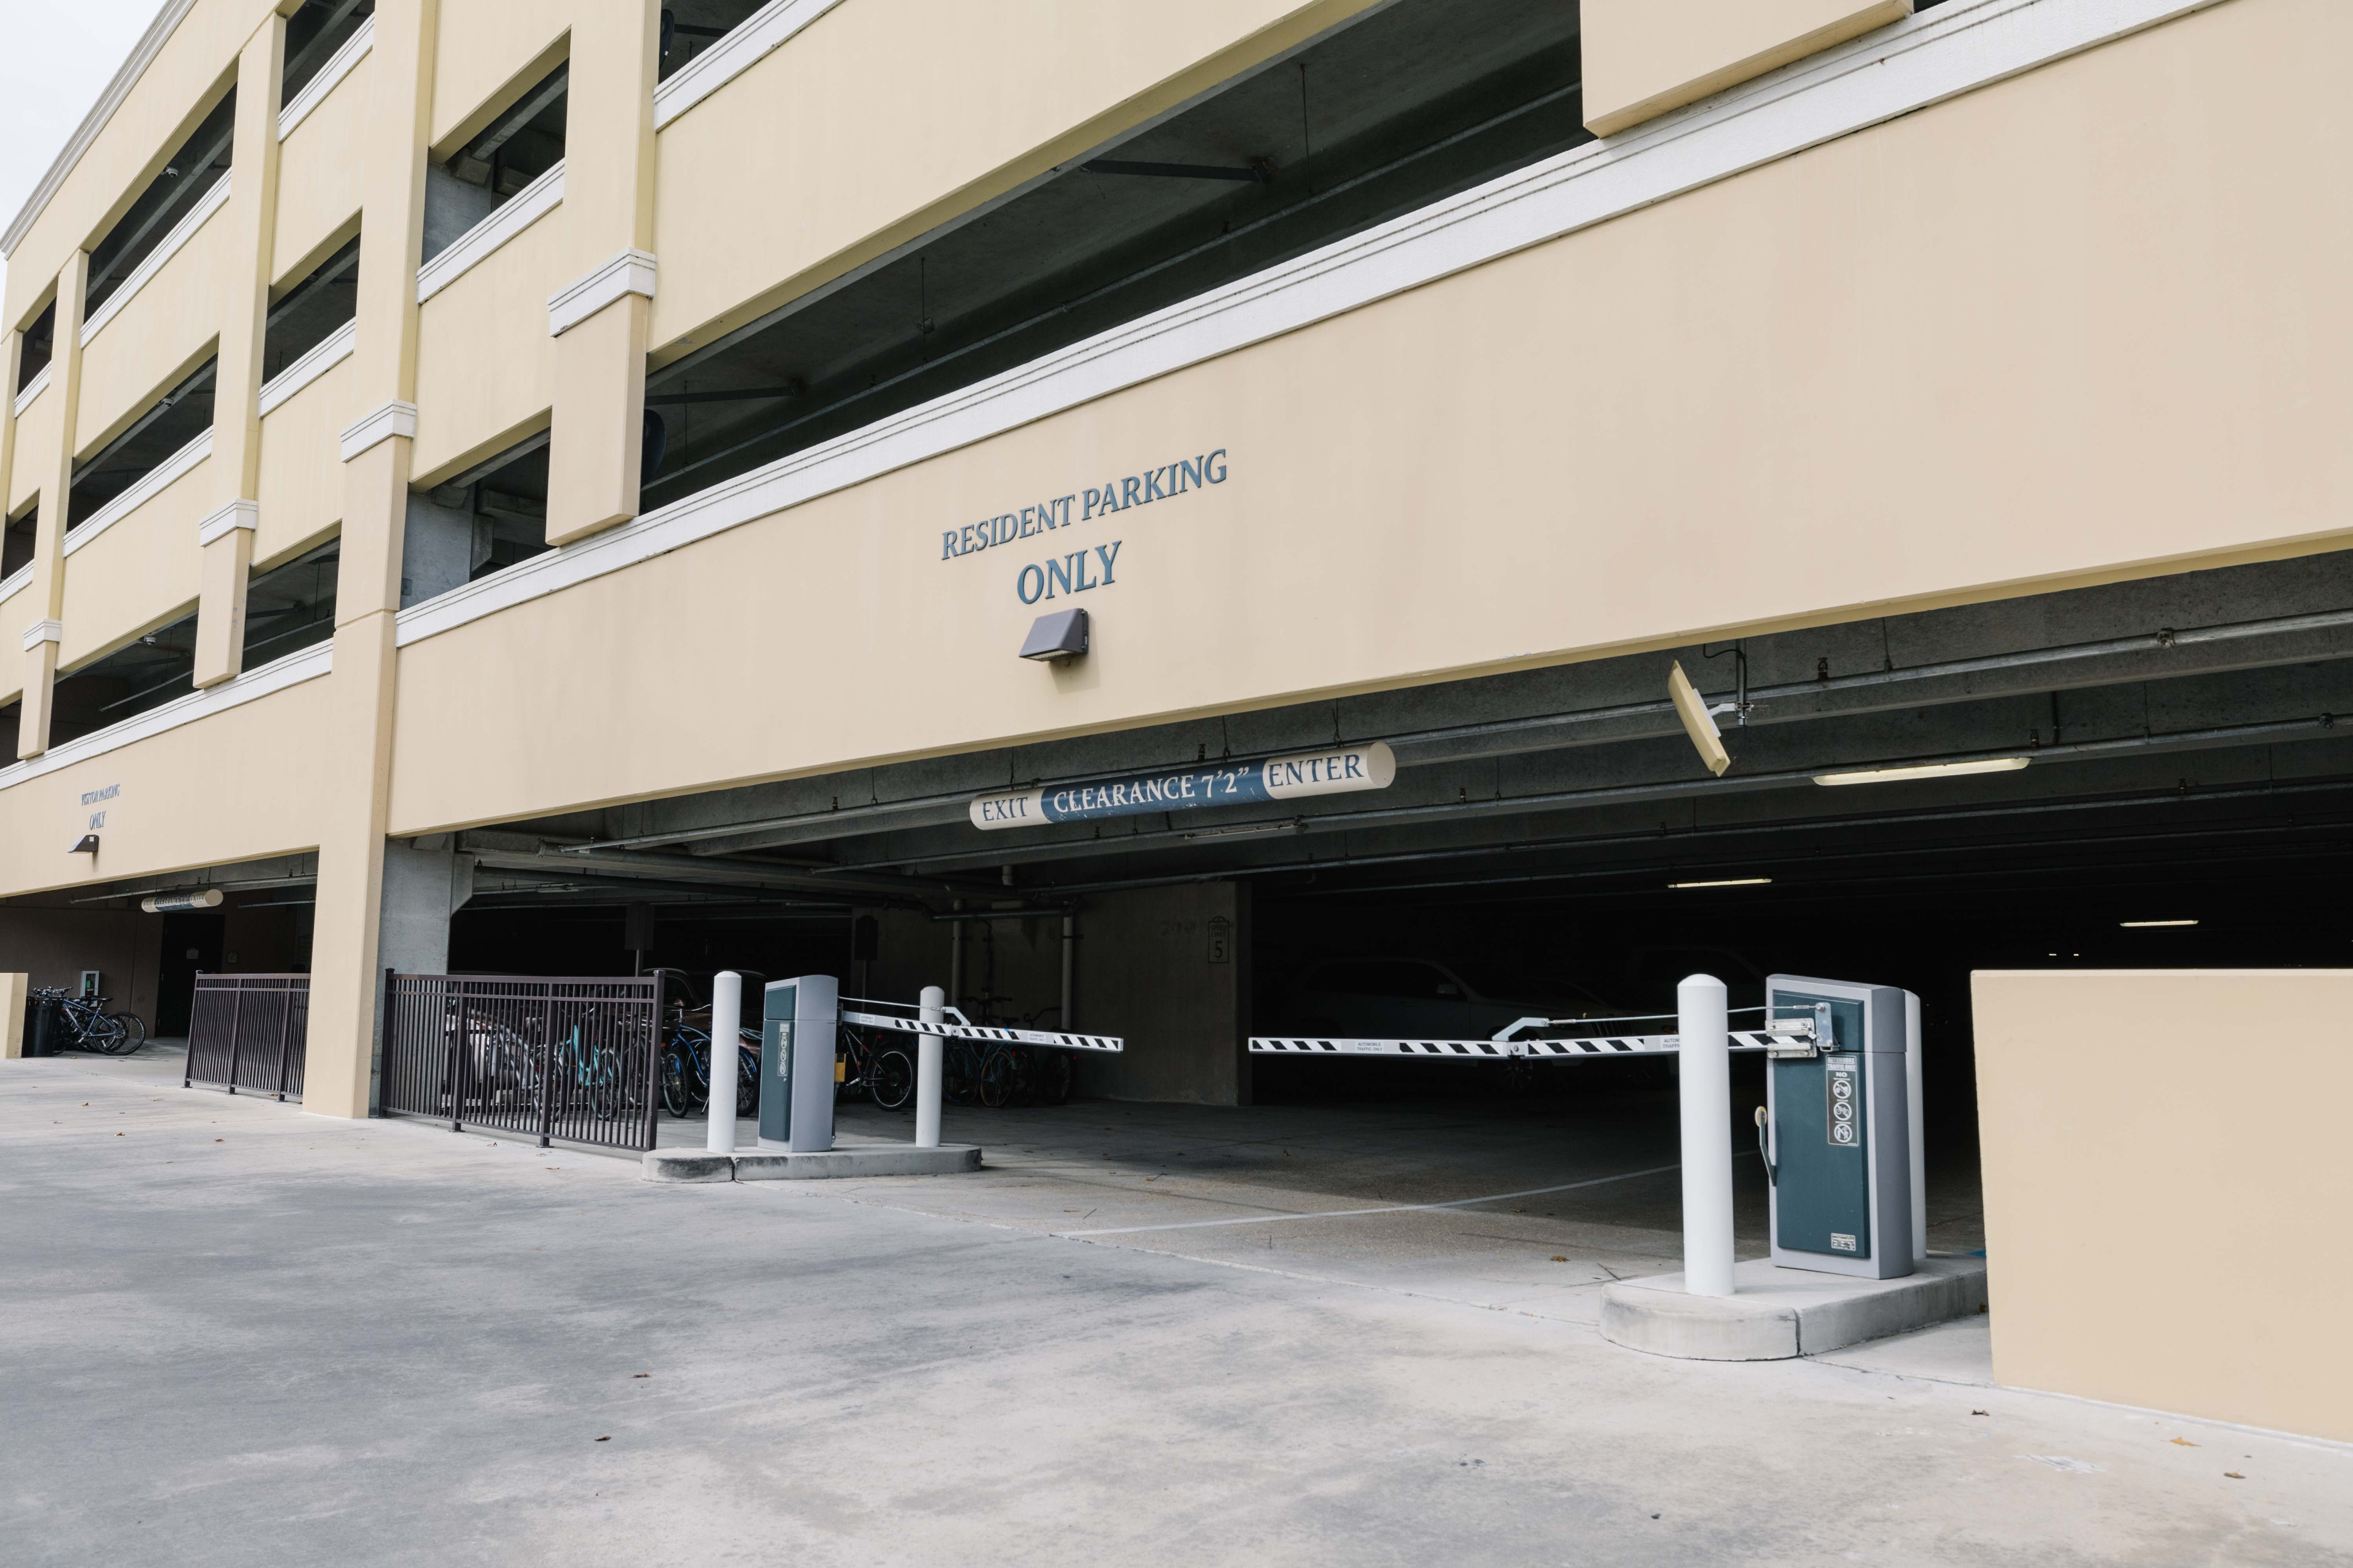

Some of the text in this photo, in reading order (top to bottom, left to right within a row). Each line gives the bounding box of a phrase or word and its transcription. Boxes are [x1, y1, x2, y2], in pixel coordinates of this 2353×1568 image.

[942, 449, 1226, 560] RESIDENT PARKING
[1017, 540, 1122, 604] ONLY
[81, 783, 120, 806] VISITOR PARKING
[982, 797, 1029, 822] EXIT
[1054, 774, 1195, 813] CLEARANCE
[1268, 754, 1364, 787] ENTER
[89, 810, 106, 831] ONLY
[1214, 940, 1223, 958] 5
